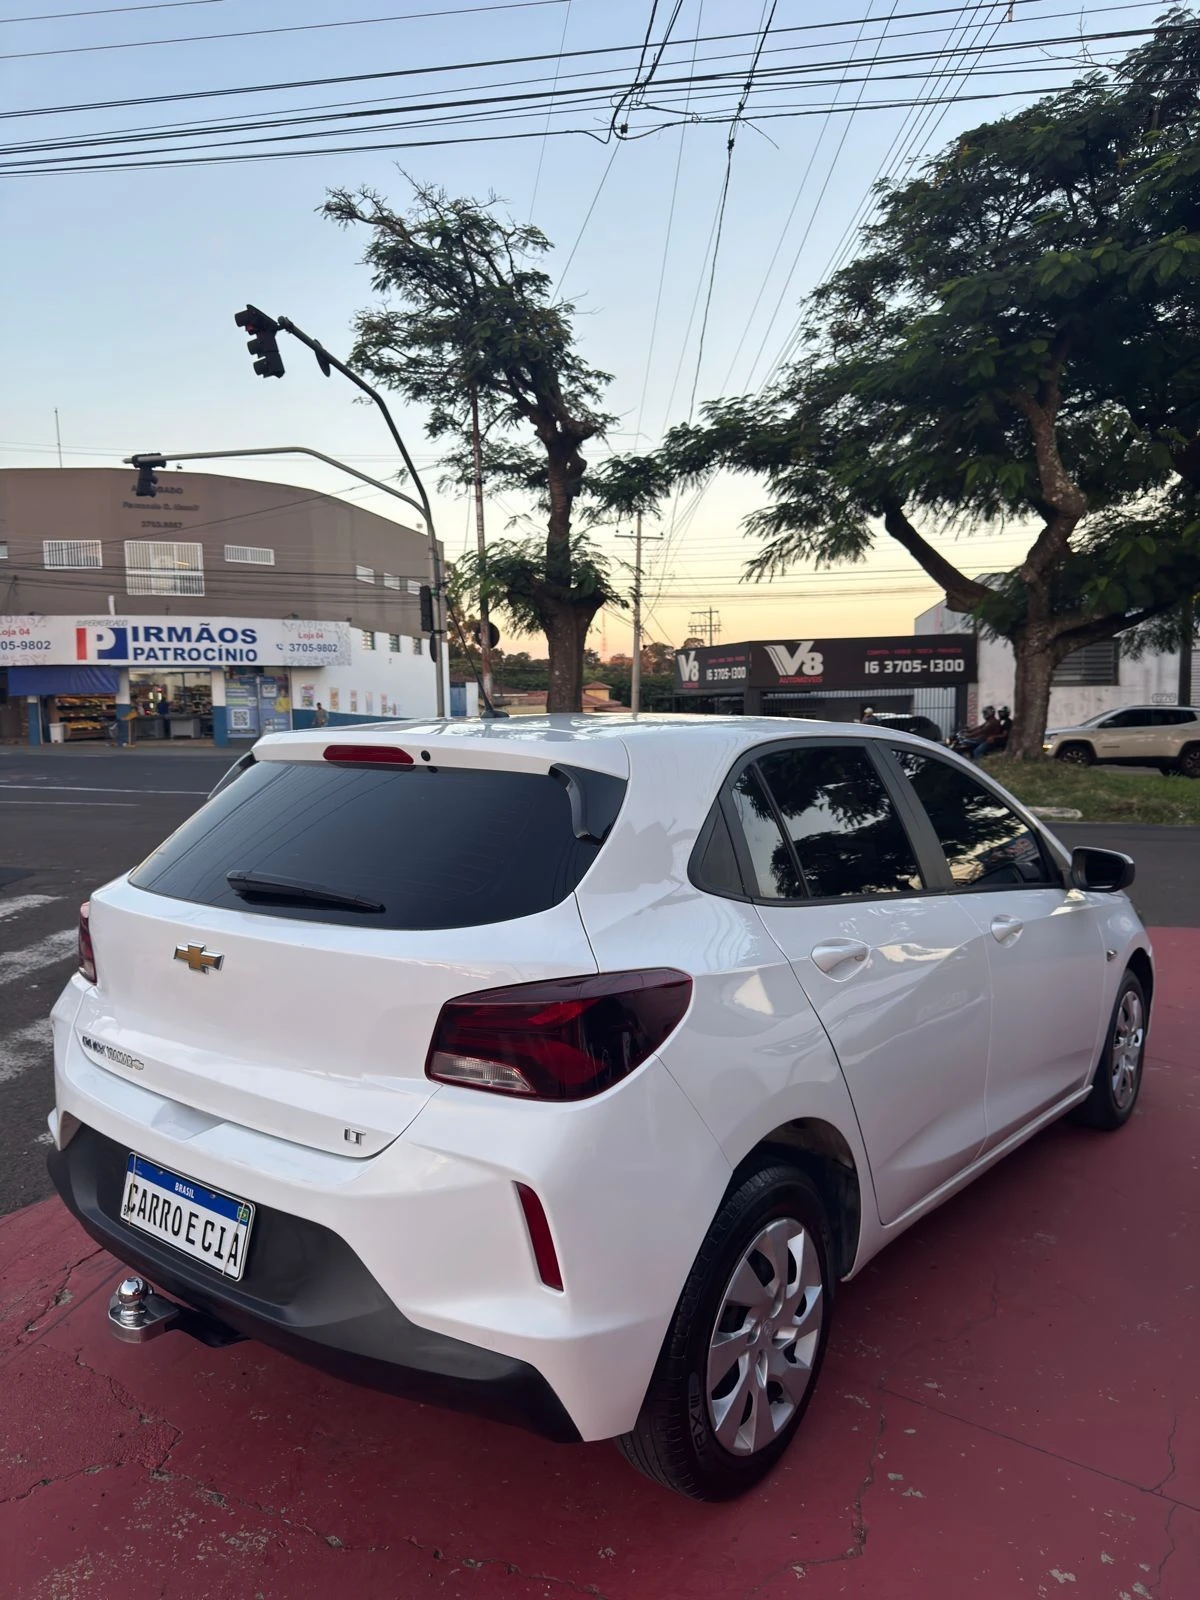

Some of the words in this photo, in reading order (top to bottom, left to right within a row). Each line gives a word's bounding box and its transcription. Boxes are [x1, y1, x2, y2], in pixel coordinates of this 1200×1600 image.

[19, 628, 30, 636] 04
[131, 622, 258, 644] IRMÃOS
[298, 632, 313, 640] Loja
[133, 645, 257, 662] PATROCÍNIO
[289, 643, 338, 653] 3705-9802
[678, 651, 699, 682] V8
[764, 641, 824, 676] V8
[864, 661, 880, 674] 16
[883, 659, 965, 673] 3705-1300
[714, 667, 746, 680] 3705-1300
[344, 1127, 366, 1146] LT
[174, 1182, 194, 1199] BRASIL
